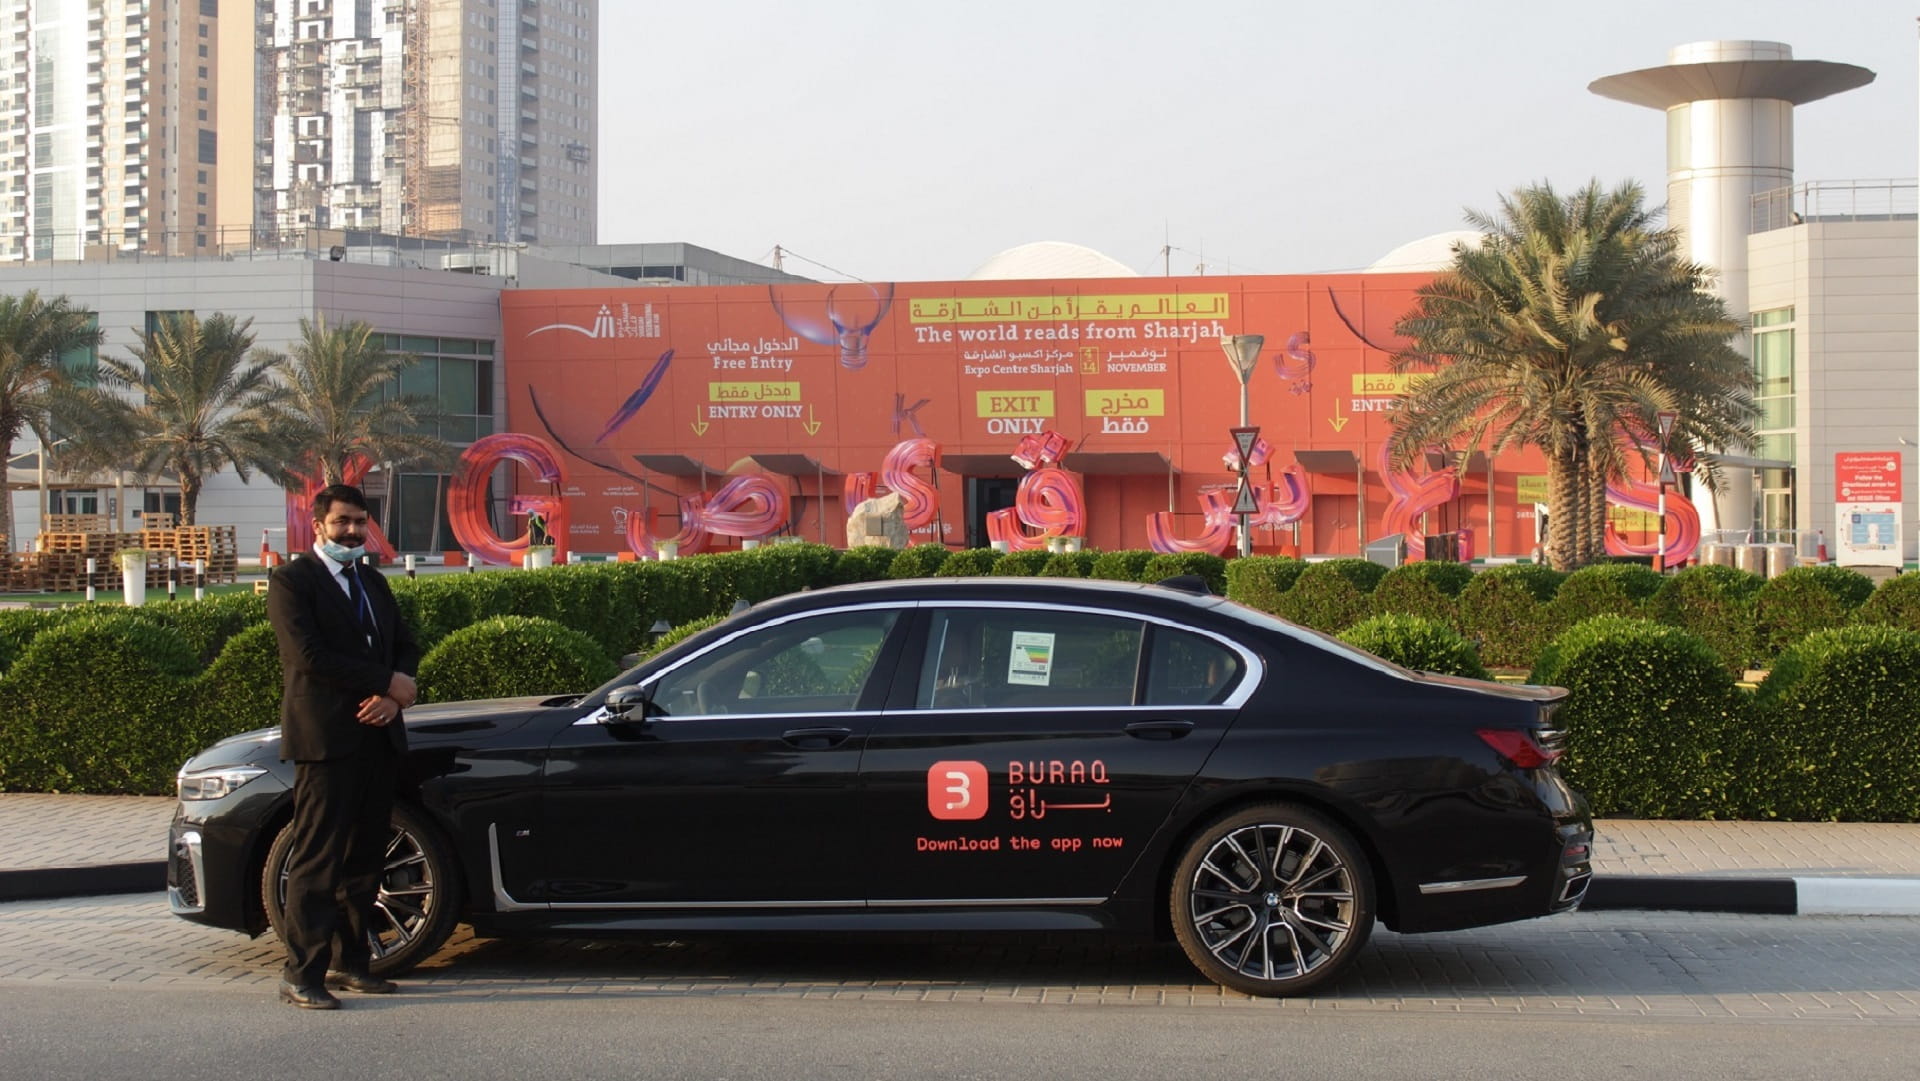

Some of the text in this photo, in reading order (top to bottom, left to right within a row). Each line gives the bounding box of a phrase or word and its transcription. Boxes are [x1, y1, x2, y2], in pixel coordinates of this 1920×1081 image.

[912, 300, 1022, 321] الشارقة
[1027, 305, 1062, 319] من
[1128, 297, 1225, 318] العالم
[915, 320, 1225, 343] The world reads from Sharjah
[706, 337, 799, 354] الدخول مجاني
[1045, 350, 1074, 361] مركز
[1107, 349, 1167, 362] نوفمبر
[713, 356, 793, 372] Free Entry
[964, 361, 1074, 378] Expo Centre Sharjah
[1107, 362, 1167, 373] NOVEMBER
[717, 383, 791, 400] مدخل فقط
[709, 405, 803, 418] ENTRY ONLY
[990, 396, 1041, 413] EXIT
[1101, 393, 1149, 415] مخرج
[987, 418, 1046, 434] ONLY
[1100, 417, 1149, 433] فقط
[1009, 760, 1110, 784] BURAQ
[917, 837, 1123, 852] Download the app now
